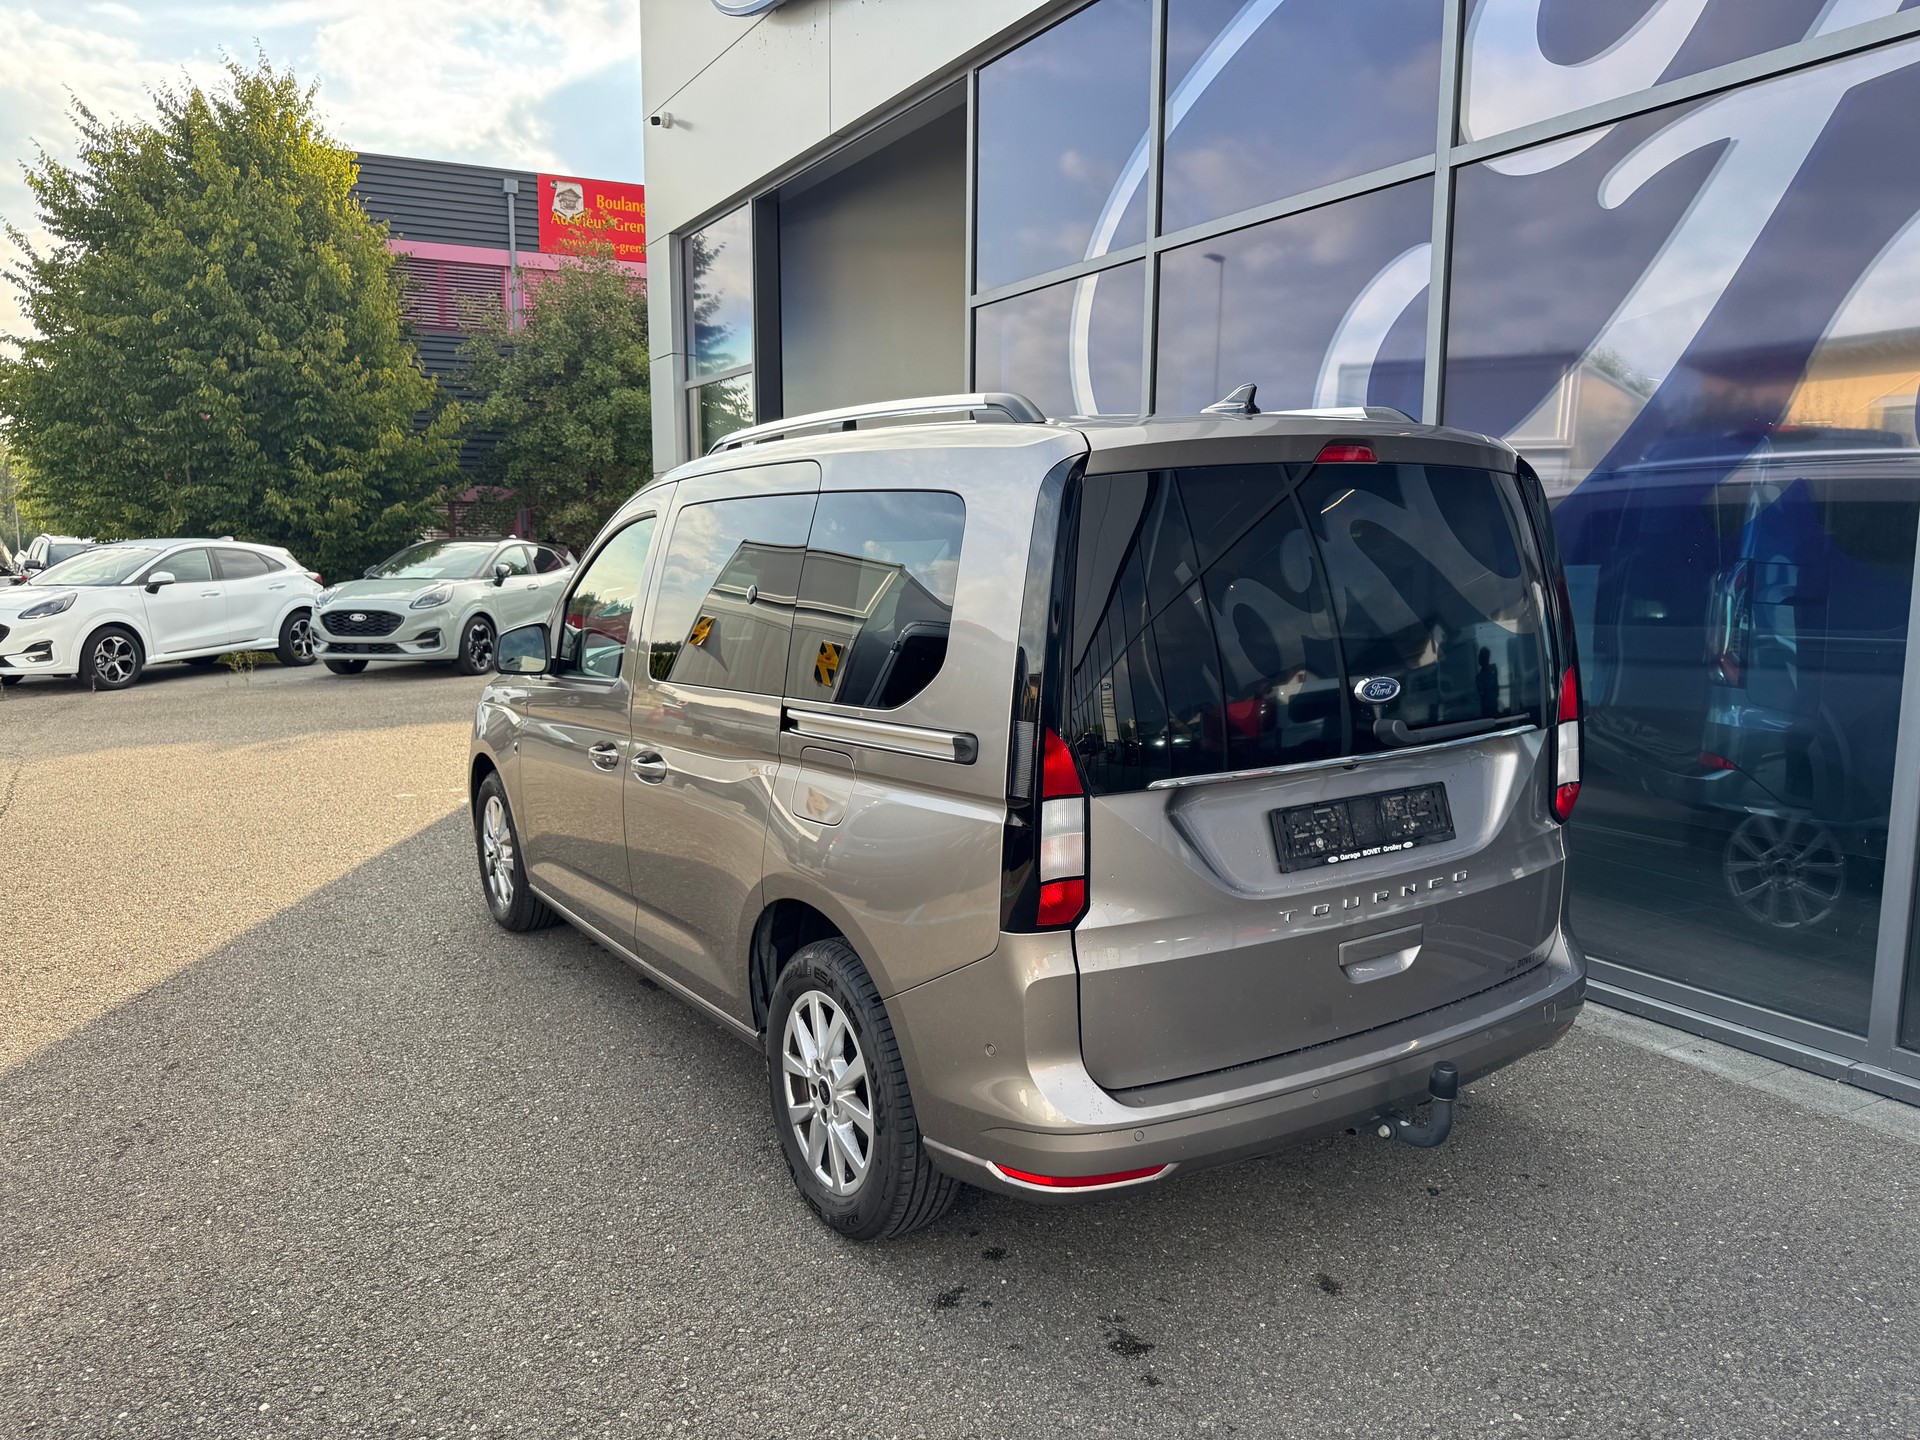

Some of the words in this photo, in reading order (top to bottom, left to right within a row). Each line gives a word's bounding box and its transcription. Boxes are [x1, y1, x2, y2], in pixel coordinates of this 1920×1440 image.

[596, 194, 646, 218] Boulang
[551, 211, 568, 226] Au
[613, 217, 645, 234] Gren
[1369, 682, 1392, 697] Ford
[1340, 852, 1361, 861] Garage
[1362, 847, 1381, 856] BOVET
[1279, 870, 1468, 923] TOURNEO
